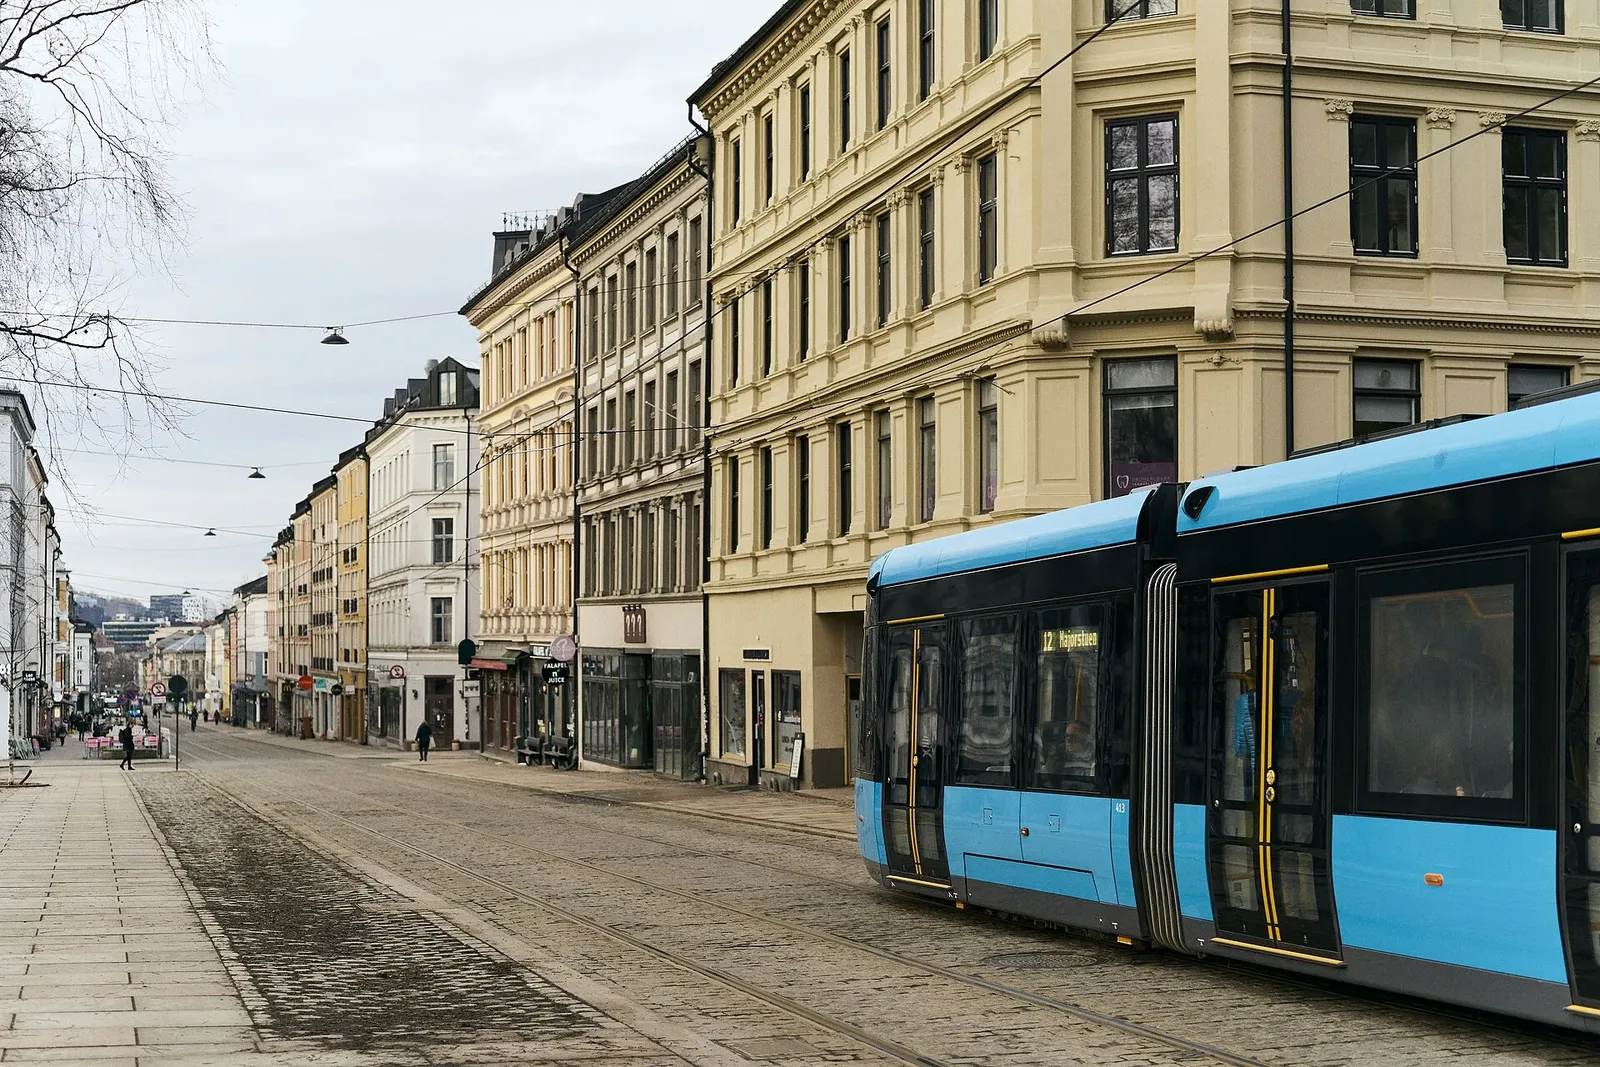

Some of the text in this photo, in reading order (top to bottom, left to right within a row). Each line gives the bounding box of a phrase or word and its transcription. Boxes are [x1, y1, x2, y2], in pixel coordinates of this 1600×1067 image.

[1043, 629, 1097, 652] 12 Majorstuen
[548, 676, 565, 684] JUICE
[1115, 802, 1125, 813] 413
